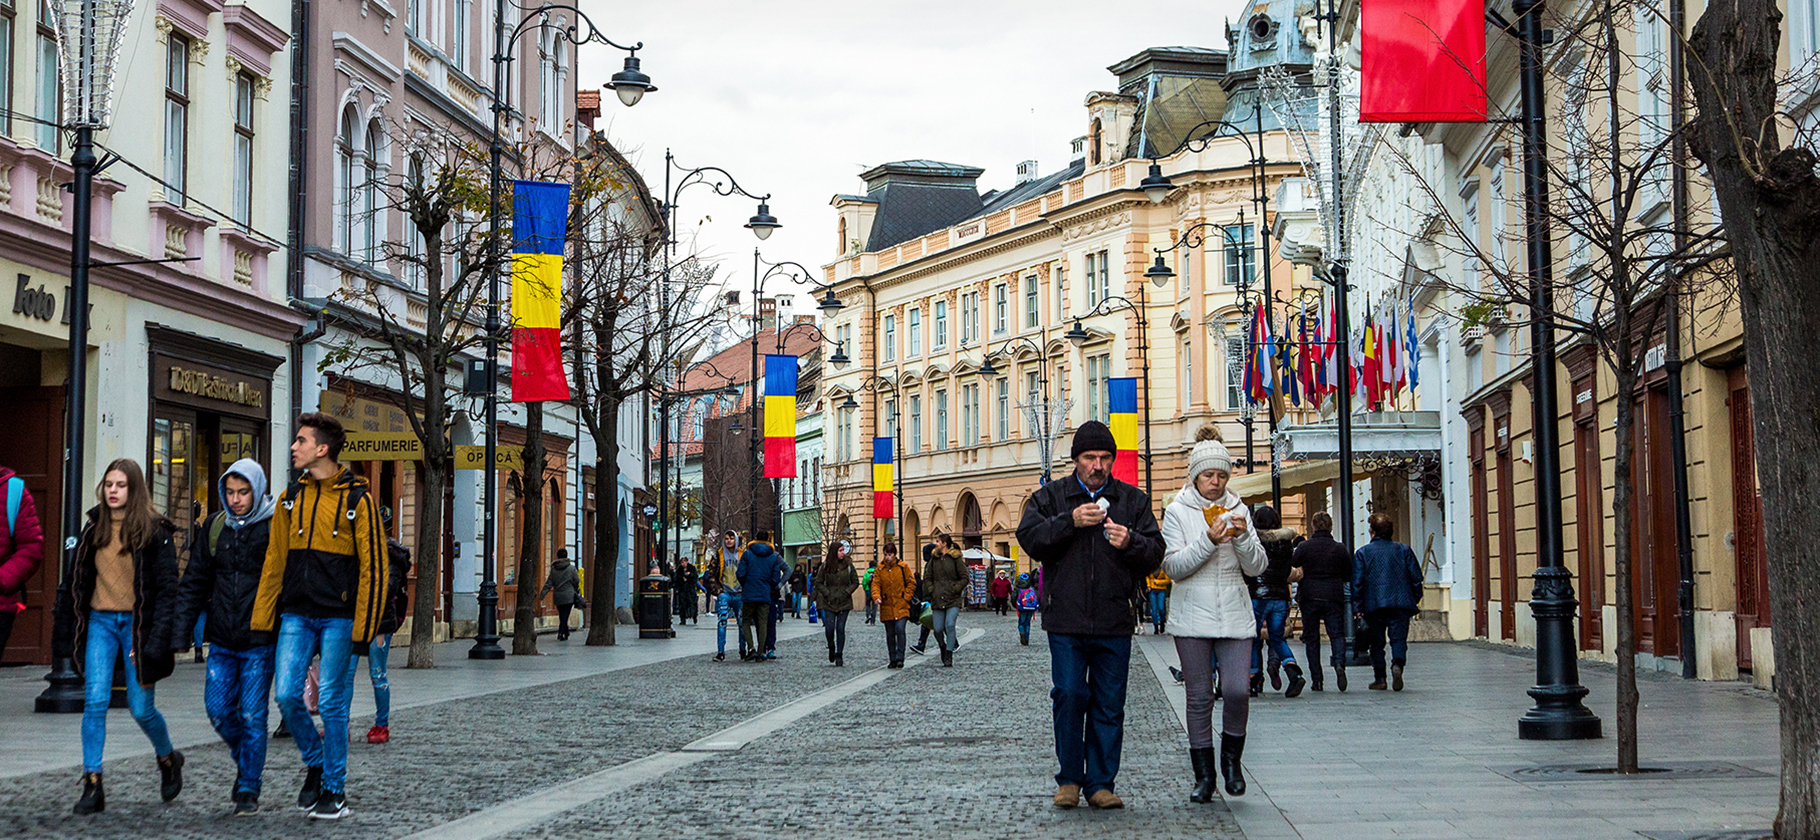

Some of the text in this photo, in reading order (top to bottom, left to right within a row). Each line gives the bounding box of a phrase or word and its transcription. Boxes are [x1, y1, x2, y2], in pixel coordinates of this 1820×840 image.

[12, 273, 56, 322] Foto
[171, 366, 199, 395] D&D
[341, 440, 419, 452] PARFUMERIE
[467, 450, 513, 463] OPCĂ
